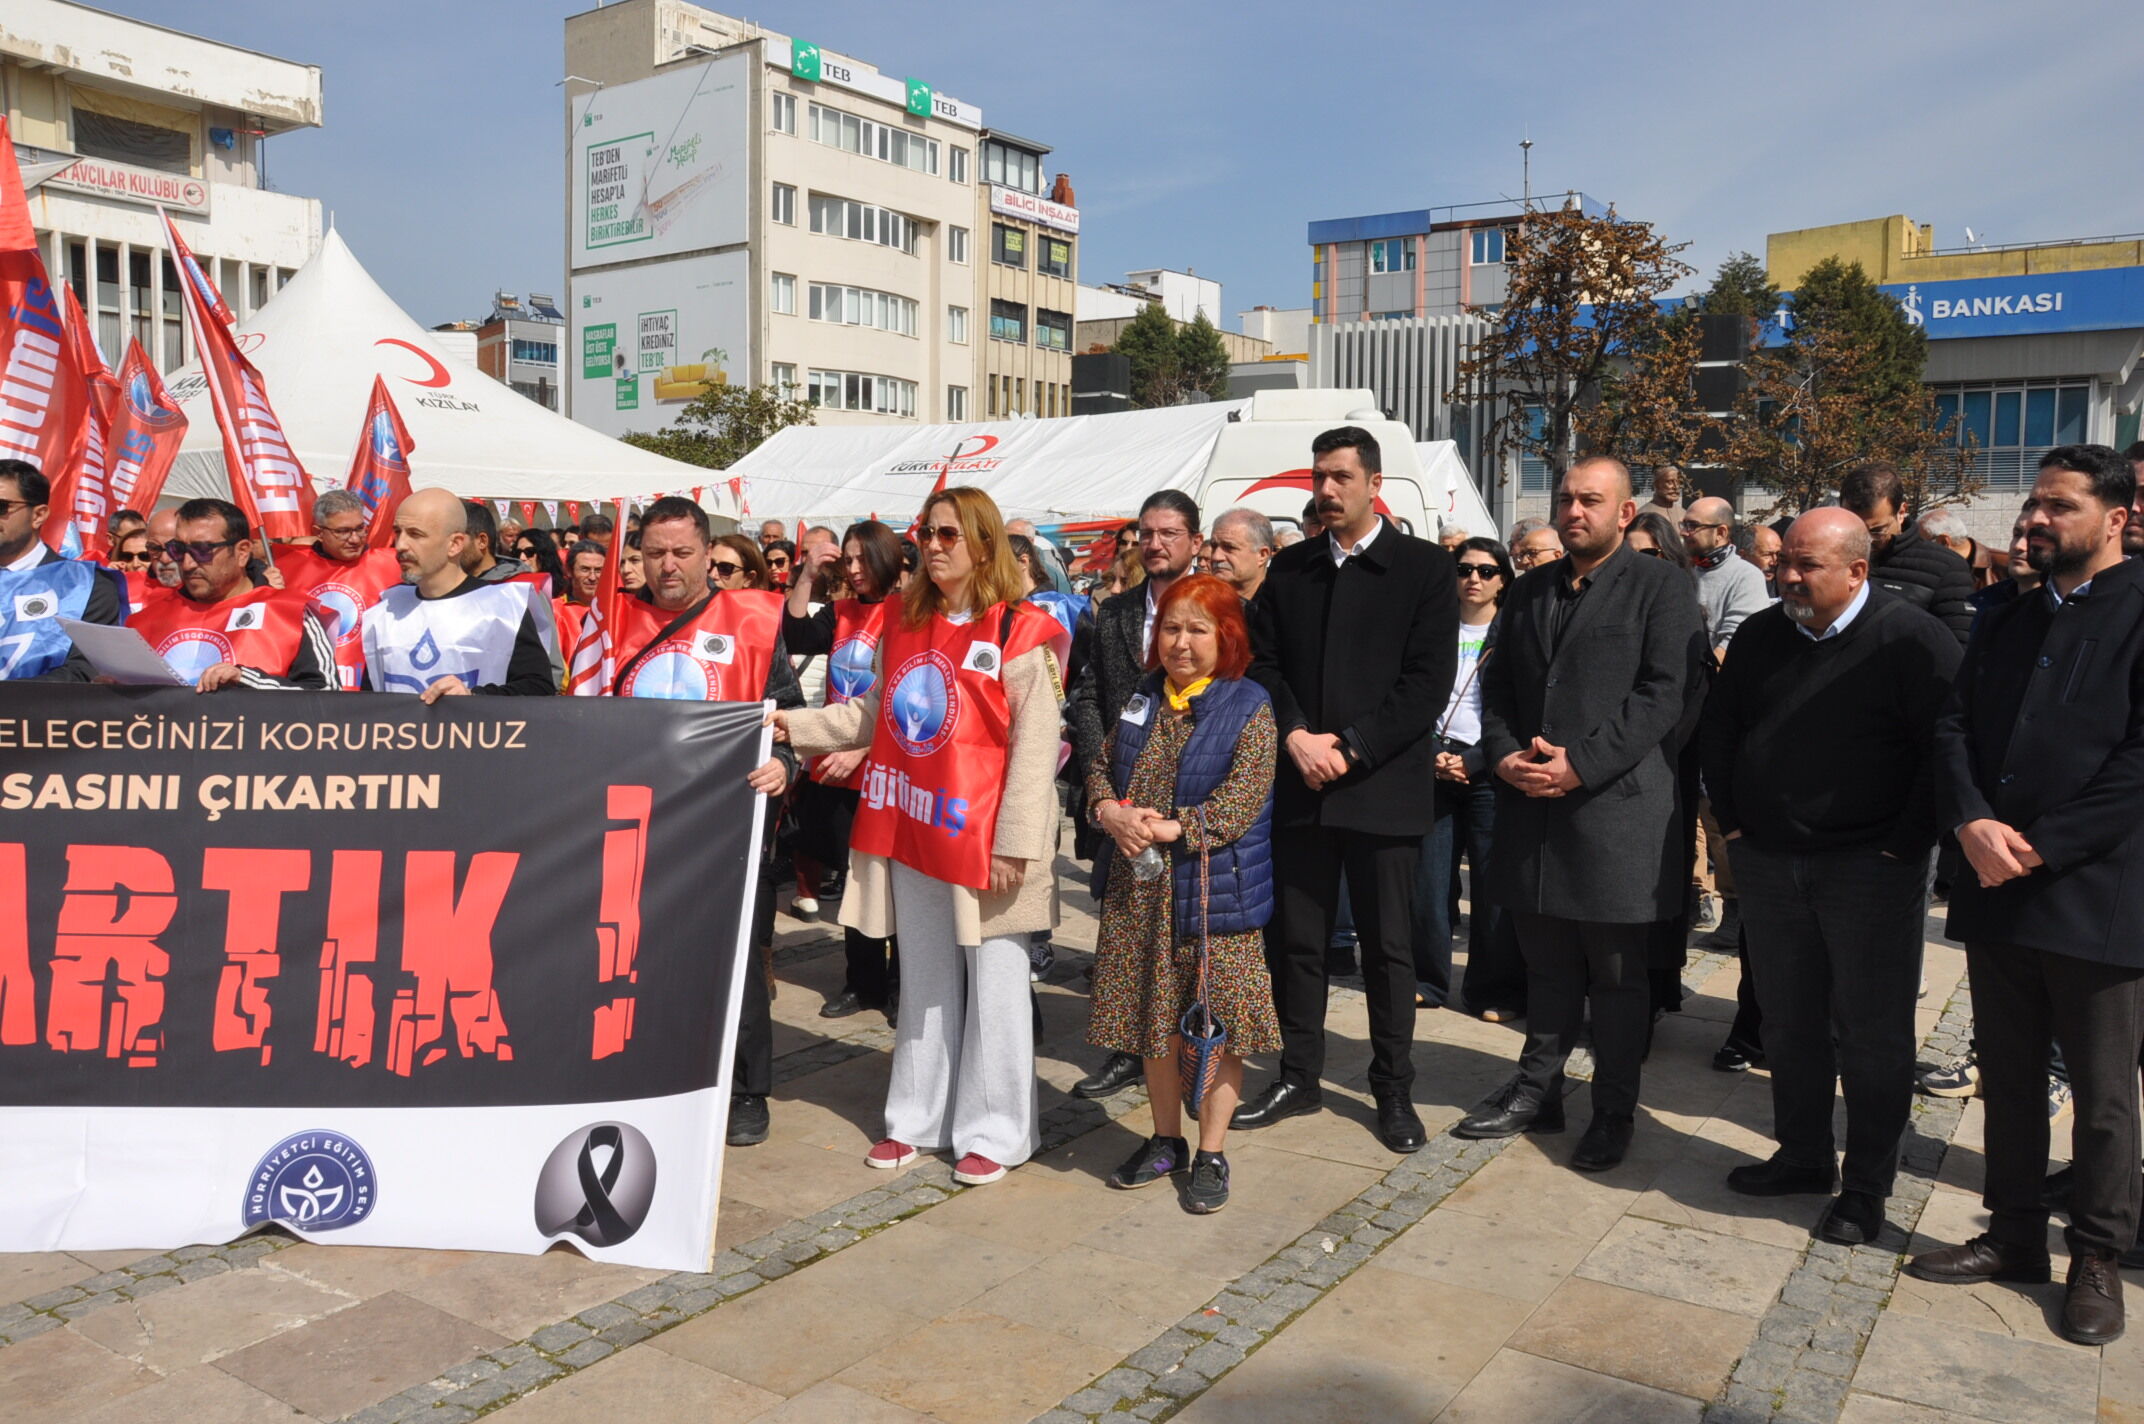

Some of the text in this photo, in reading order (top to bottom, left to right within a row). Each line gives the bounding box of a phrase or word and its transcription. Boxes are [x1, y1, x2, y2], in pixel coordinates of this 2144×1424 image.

[823, 62, 851, 82] TEB
[933, 99, 957, 117] TEB
[591, 147, 621, 168] TEB'DEN
[71, 164, 127, 189] AVCILAR
[130, 174, 179, 200] KULÜBÜ
[591, 184, 625, 204] HESAP'LA
[591, 204, 618, 223] HERKES
[1004, 193, 1035, 212] BİLİCİ
[1039, 200, 1079, 223] İNŞAAT
[1932, 292, 2063, 319] BANKASI
[641, 352, 665, 368] TEB'DE
[416, 397, 480, 412] KIZILAY
[260, 720, 527, 751] KORURSUNUZ
[1, 773, 440, 822] SASINI ÇIKARTIN
[252, 1136, 368, 1216] HÜRRİYETÇİ EĞİTİM SEN
